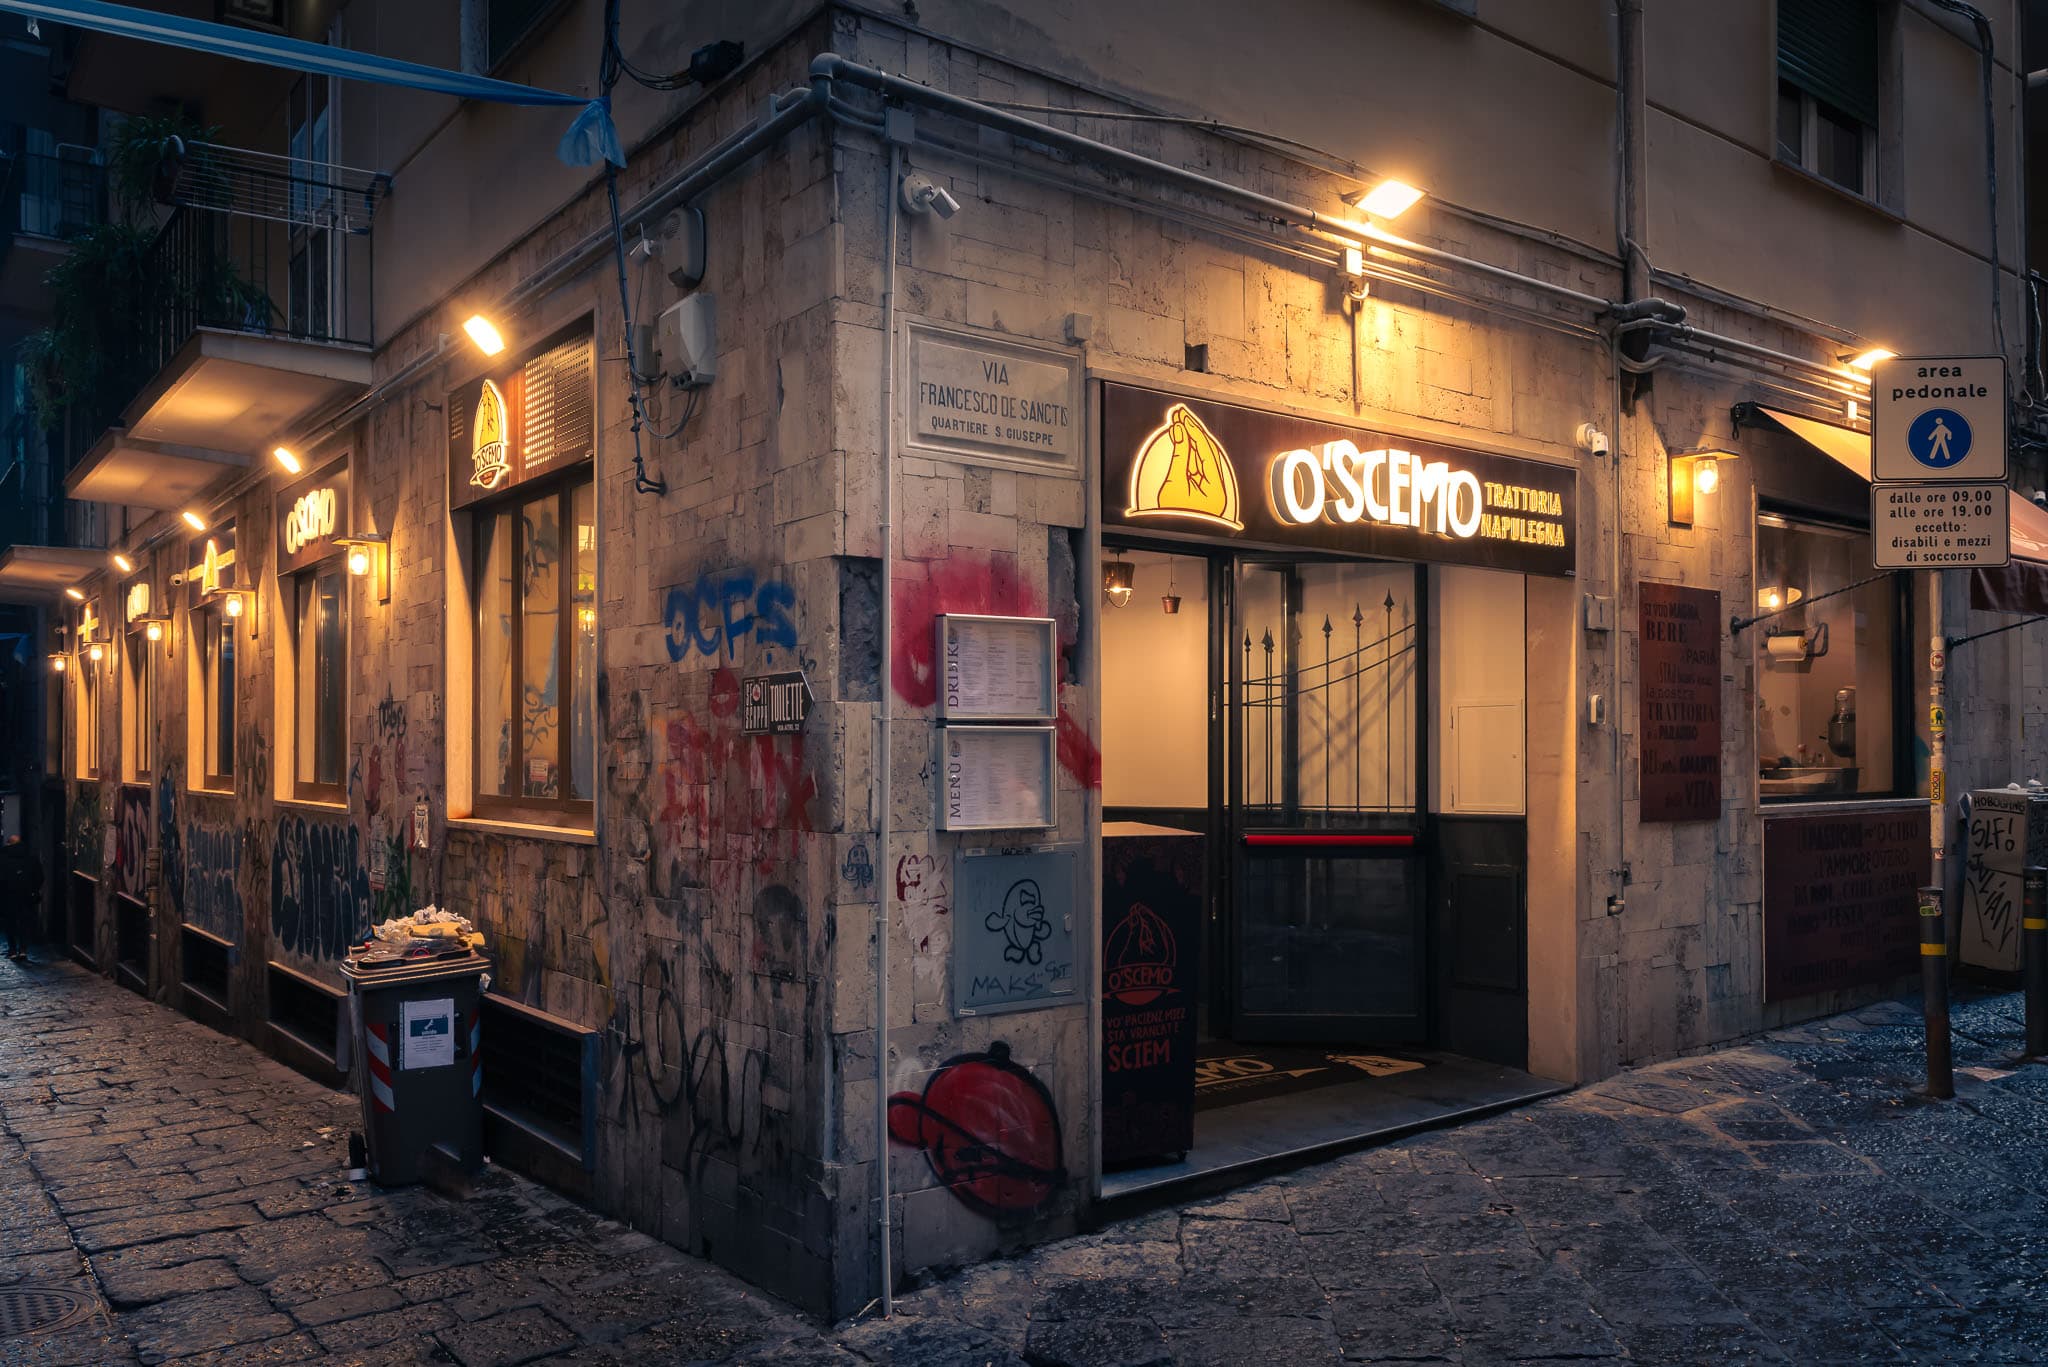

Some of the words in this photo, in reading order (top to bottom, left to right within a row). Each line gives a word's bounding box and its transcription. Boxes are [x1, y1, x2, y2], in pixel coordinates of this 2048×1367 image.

[982, 360, 1009, 386] VIA
[1917, 366, 1962, 378] area
[1892, 383, 1988, 402] pedonale
[920, 382, 998, 416] FRANCESCO
[1001, 396, 1017, 419] DE
[1020, 398, 1069, 427] SANCTIS
[931, 415, 989, 436] QUARTIERE
[995, 425, 1005, 439] S.
[1006, 427, 1054, 446] GIUSEPPE
[1273, 439, 1482, 538] O'SCEMO
[1484, 481, 1562, 516] TRATTORIA
[1889, 491, 1921, 504] dalle
[1926, 494, 1946, 503] ore
[1952, 490, 1992, 503] 09.00
[1889, 506, 1917, 518] alle
[1923, 508, 1944, 518] ore
[1951, 504, 1992, 518] 19.00
[1480, 513, 1565, 547] NAPULEGNA
[1914, 521, 1967, 533] eccetto:
[1891, 535, 1938, 548] disabili
[1943, 539, 1951, 547] e
[1956, 534, 1991, 547] mezzi
[1906, 550, 1917, 562] di
[1923, 552, 1977, 562] soccorso
[1646, 621, 1688, 643] BERE
[769, 681, 805, 722] TOILETTE
[1647, 701, 1716, 722] TRATTORIA
[1107, 1039, 1171, 1072] SCIEM
